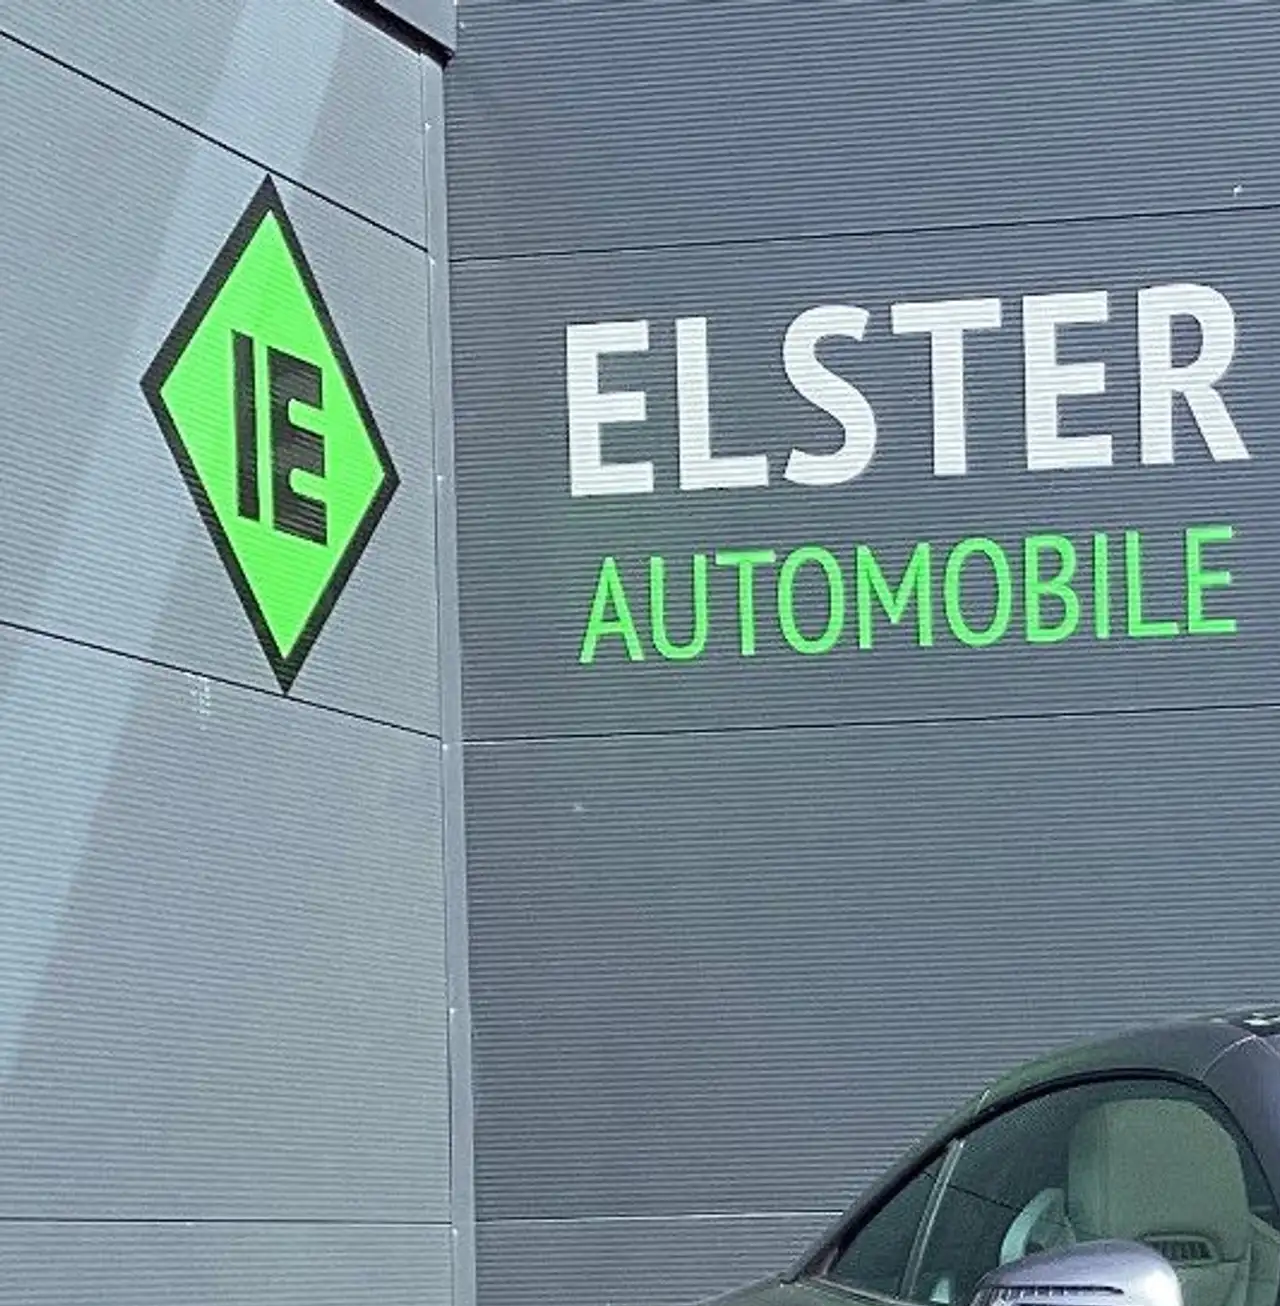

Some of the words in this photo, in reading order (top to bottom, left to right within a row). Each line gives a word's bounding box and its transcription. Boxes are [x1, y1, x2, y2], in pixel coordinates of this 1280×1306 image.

[231, 329, 328, 546] IE
[566, 283, 1251, 497] ELSTER
[580, 525, 1237, 664] AUTOMOBILE
